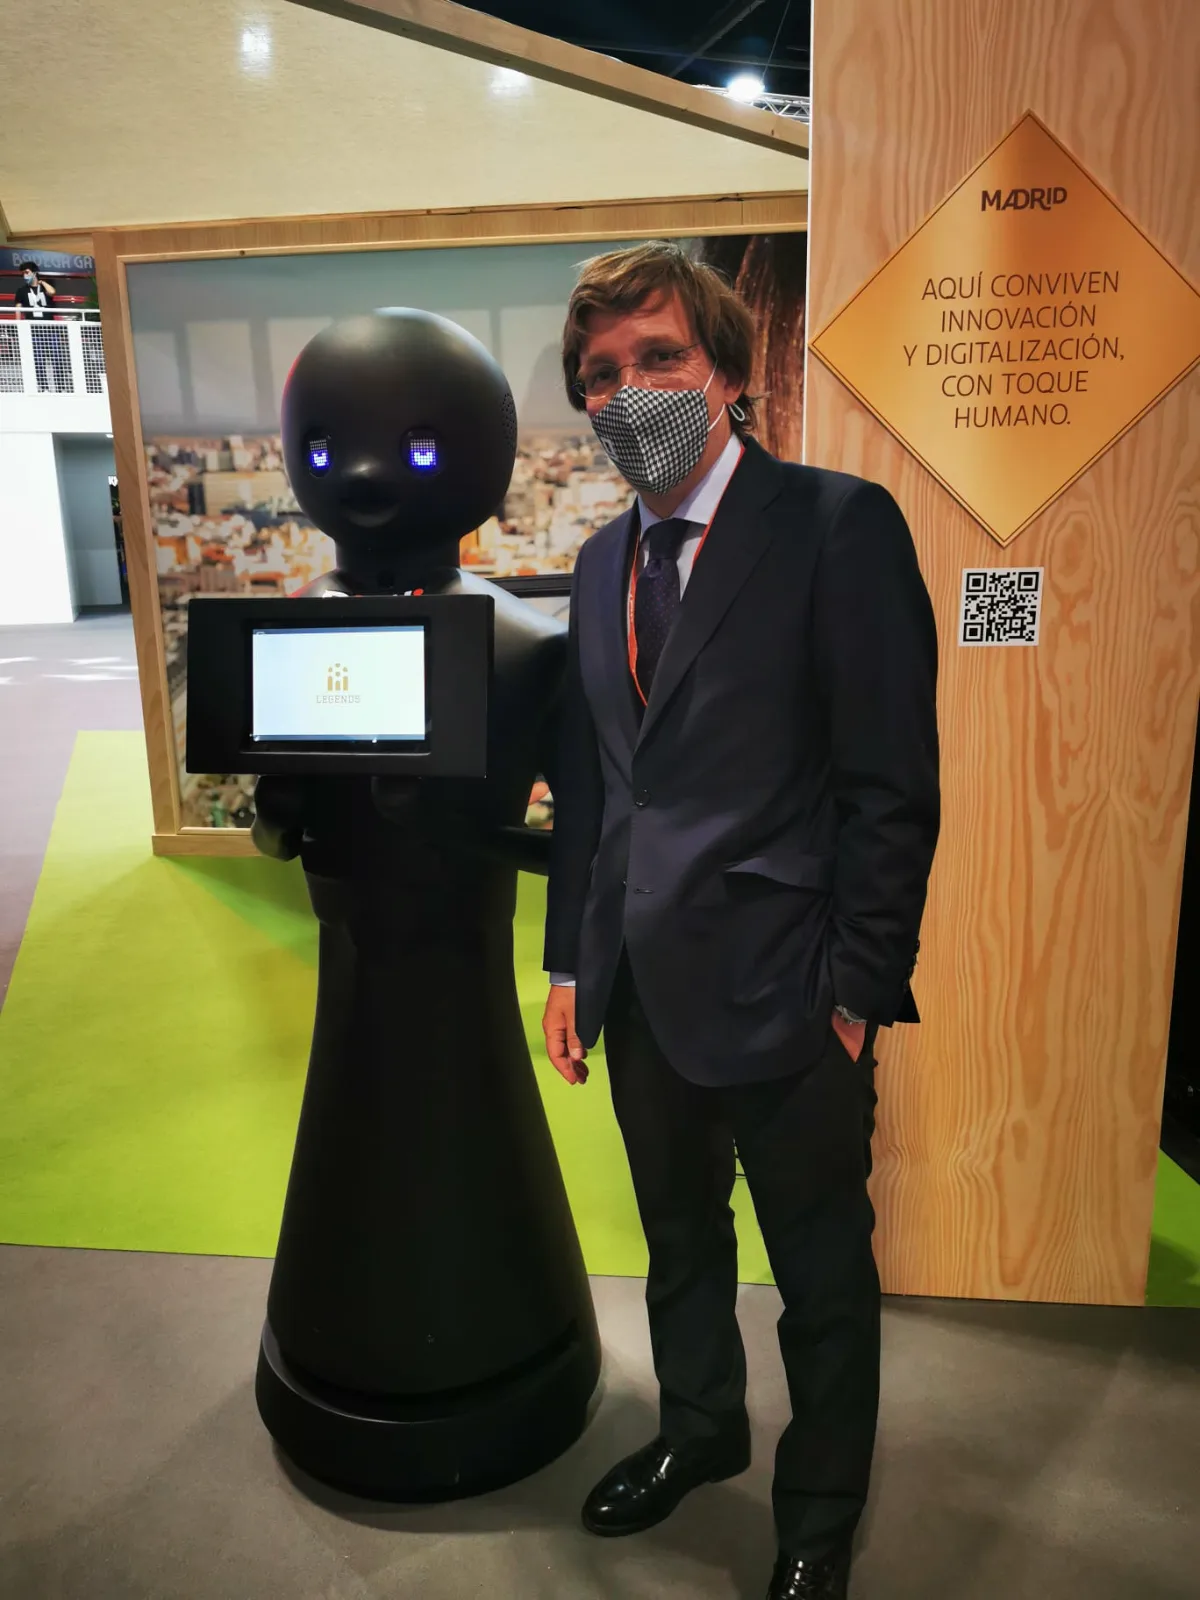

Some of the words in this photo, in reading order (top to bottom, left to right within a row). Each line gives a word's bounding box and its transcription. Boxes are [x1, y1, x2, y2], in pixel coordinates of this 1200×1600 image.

[981, 187, 1067, 211] MADRID
[921, 271, 983, 300] AQUÍ
[991, 270, 1120, 297] CONVIVEN
[941, 300, 1096, 332] INNOVACIÓN
[903, 344, 918, 367] Y
[926, 332, 1125, 366] DIGITALIZACIÓN,
[941, 373, 992, 397] CON
[1001, 371, 1089, 397] TOQUE
[954, 403, 1071, 429] HUMANO.
[316, 695, 361, 704] LEGENDS
